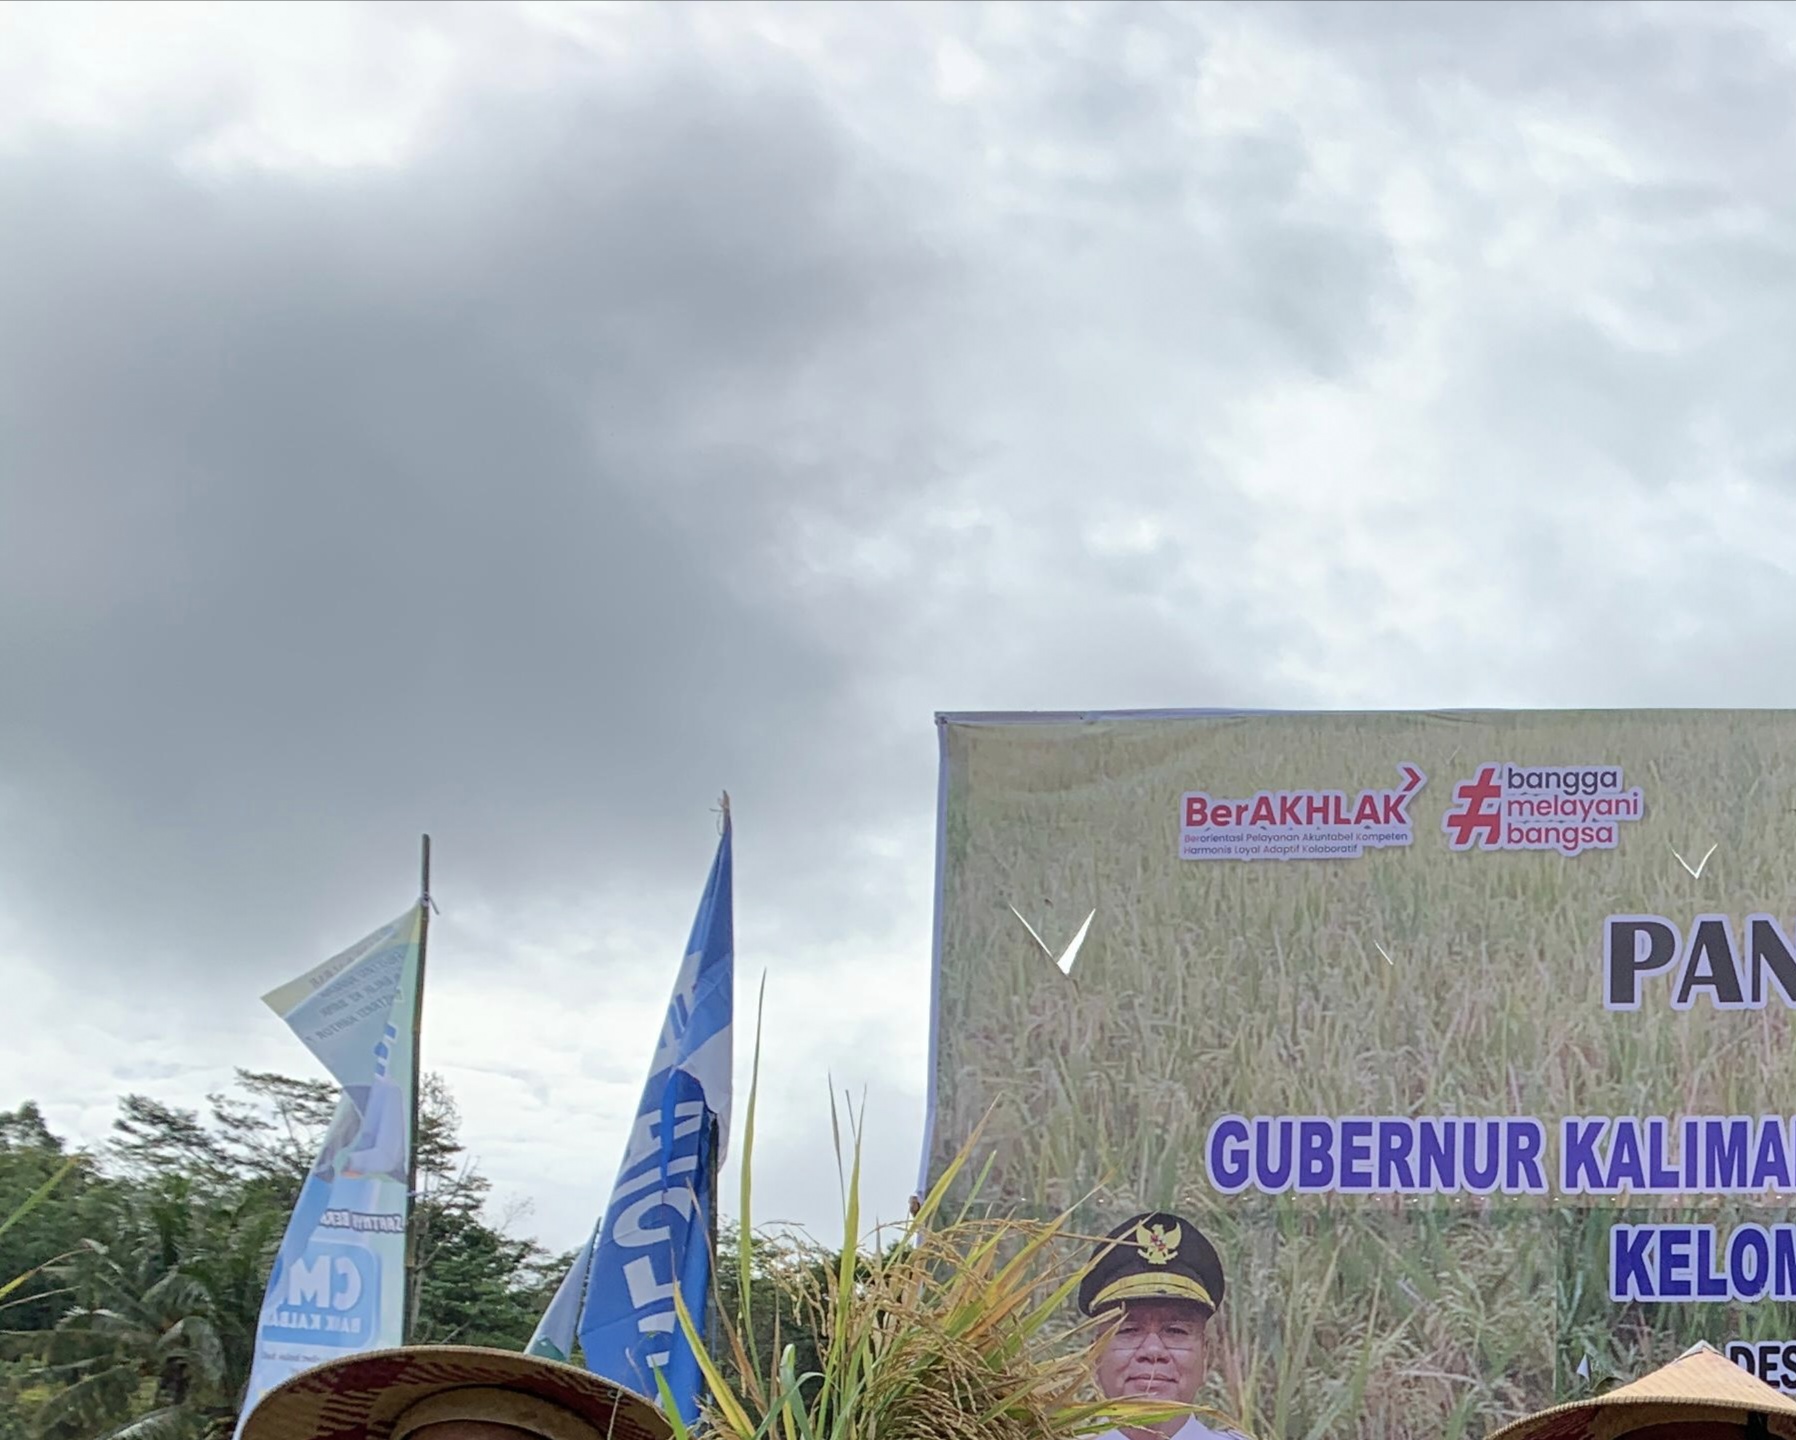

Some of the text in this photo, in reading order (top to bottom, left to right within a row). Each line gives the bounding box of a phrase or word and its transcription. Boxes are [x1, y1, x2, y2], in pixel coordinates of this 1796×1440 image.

[1508, 768, 1617, 796] bangga
[1186, 795, 1407, 826] BerAKHLAK
[1508, 792, 1638, 821] melayani
[1184, 844, 1357, 857] Harmonis Loyal Adaptif Kolaboratif
[1185, 832, 1408, 844] Berorientasi Pelayanan Akuntabel Kompeten
[1507, 823, 1612, 850] bangsa
[1211, 1119, 1542, 1189] GUBERNUR
